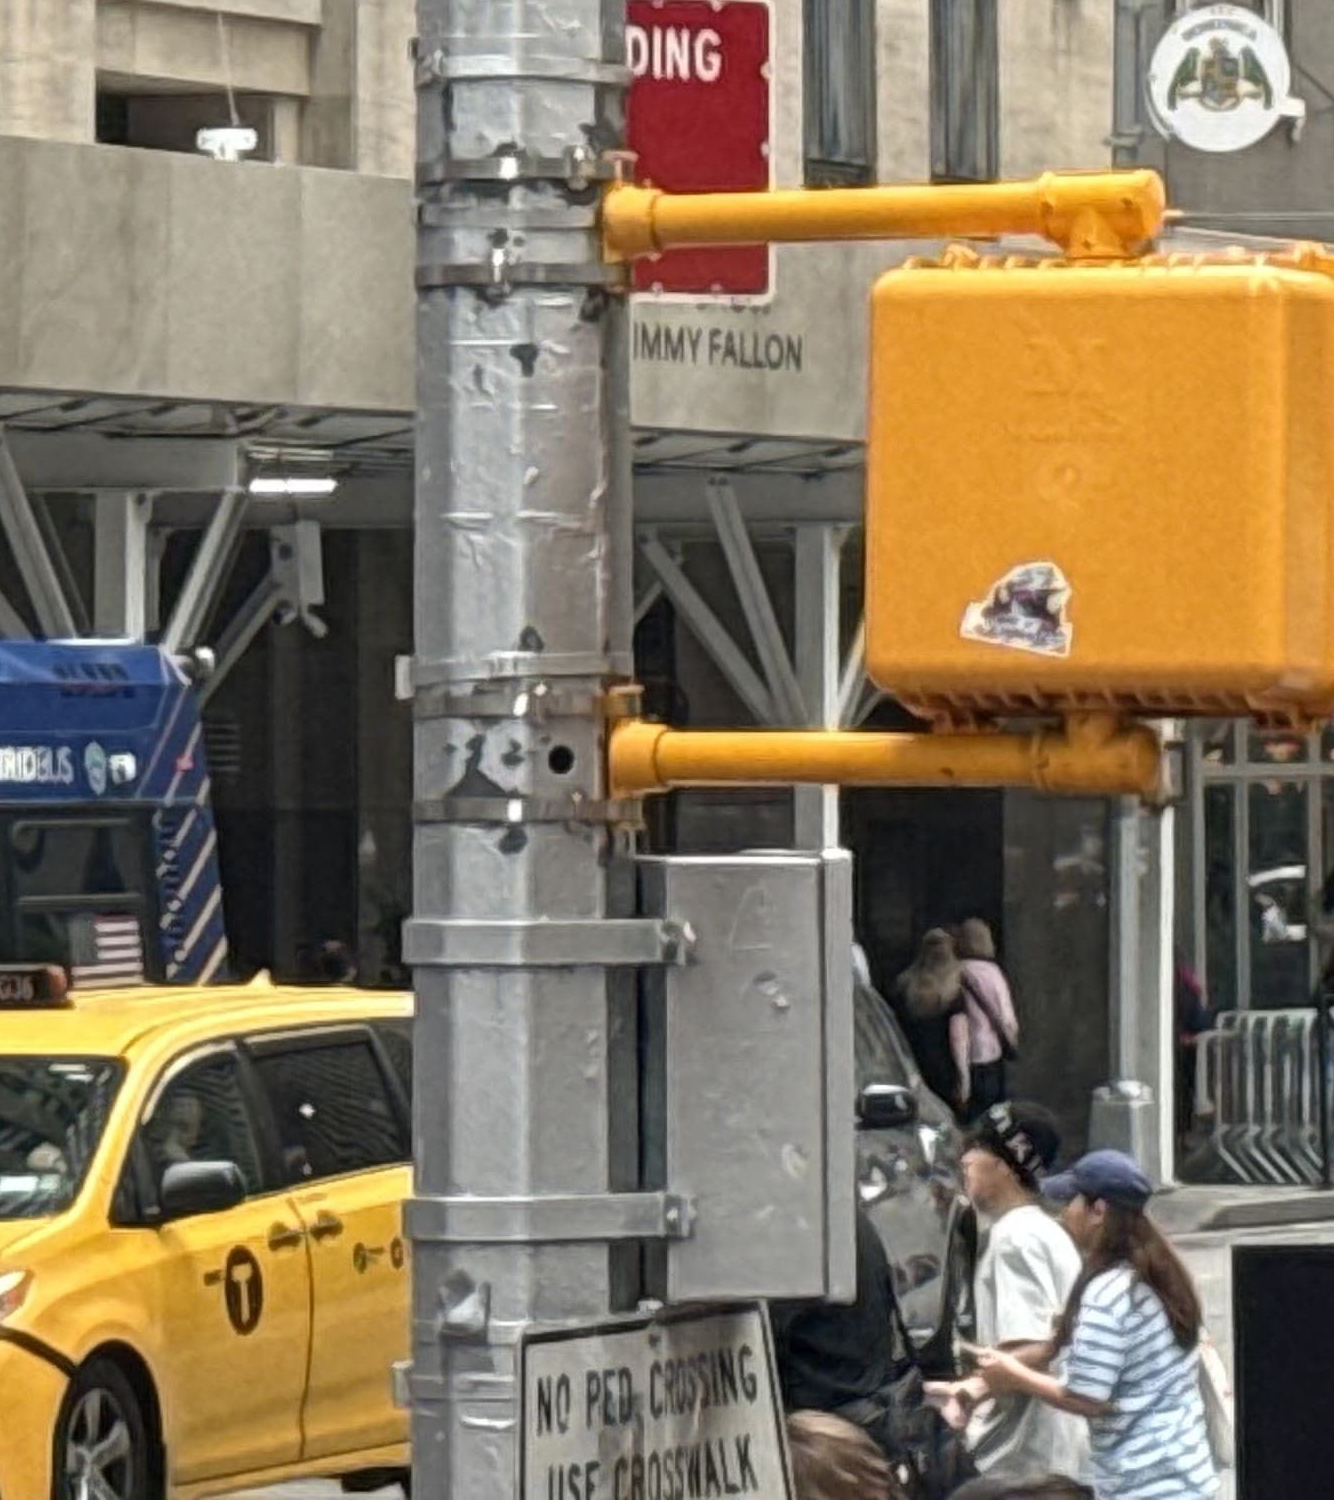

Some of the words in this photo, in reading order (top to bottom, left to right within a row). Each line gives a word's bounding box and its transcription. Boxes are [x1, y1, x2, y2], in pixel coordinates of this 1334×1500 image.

[708, 328, 804, 372] FALLON
[536, 1372, 571, 1436] NO
[585, 1366, 633, 1429] PED
[649, 1342, 758, 1421] CROSSING
[547, 1460, 601, 1500] USE
[613, 1432, 759, 1500] CROSSWALK
